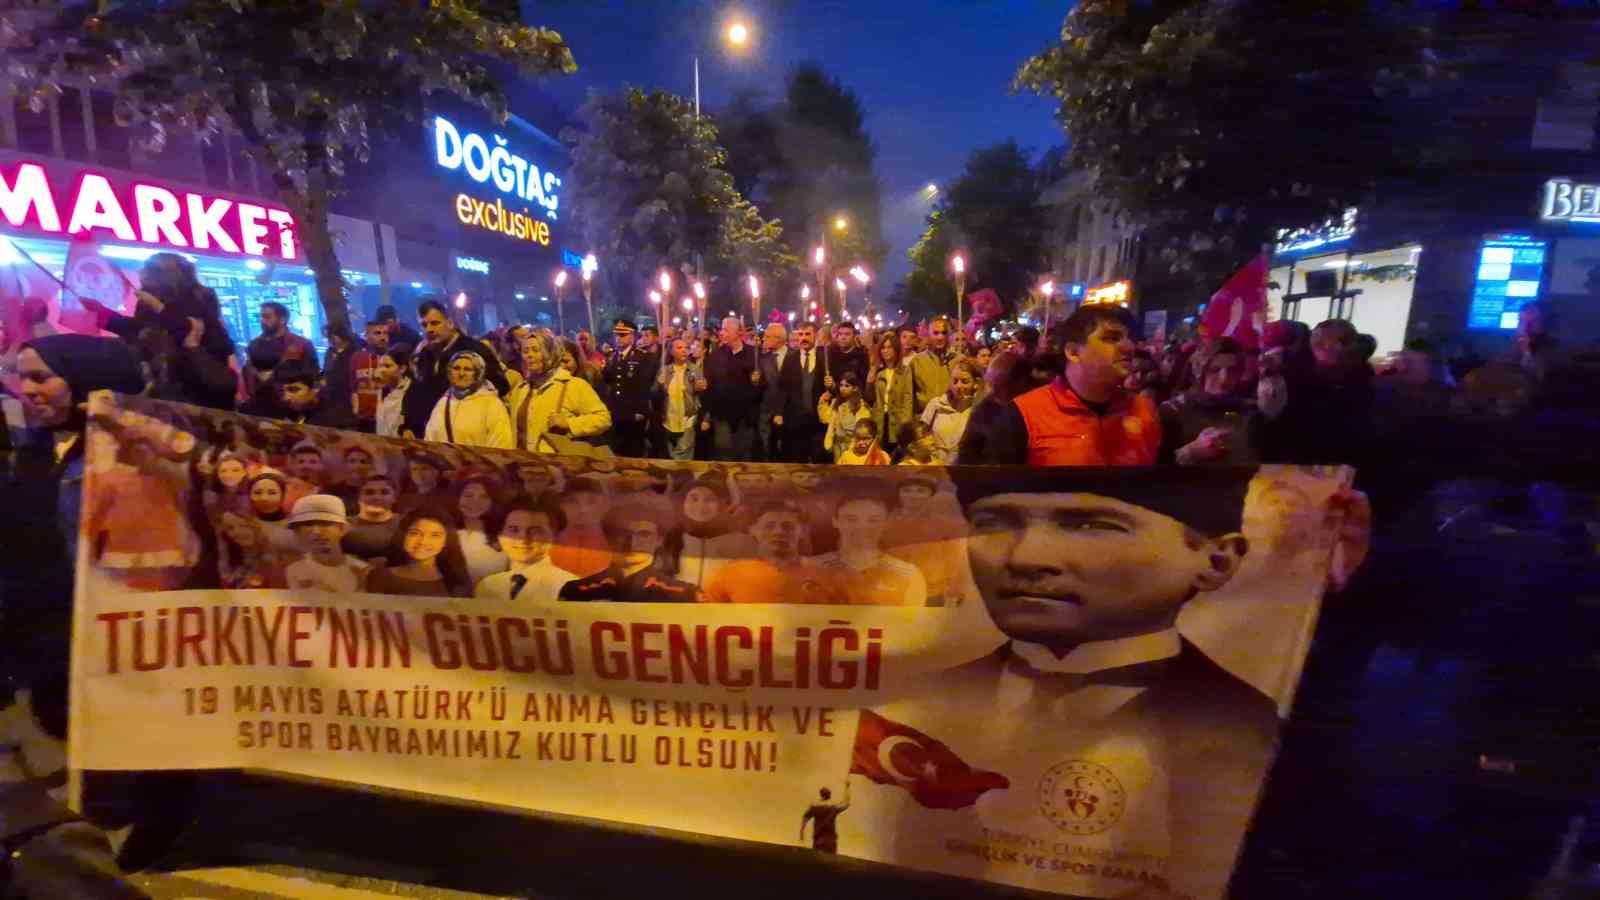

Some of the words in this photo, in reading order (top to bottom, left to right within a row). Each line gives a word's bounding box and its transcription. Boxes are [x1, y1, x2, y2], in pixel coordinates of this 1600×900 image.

[434, 116, 562, 220] DOĞTAŞ
[456, 193, 551, 247] exclusive
[1543, 179, 1600, 221] BE
[425, 613, 574, 675] GÜCÜ
[591, 619, 882, 692] GENÇLİĞİ
[183, 686, 219, 716] 19
[234, 686, 323, 714] MAYIS
[337, 685, 506, 720] ATATÜRK'Ü
[523, 692, 614, 723] ANMA
[631, 700, 777, 734] GENÇLİK
[792, 707, 836, 738] VE
[237, 720, 315, 751] SPOR
[328, 725, 521, 758] BAYRAMIMIZ
[538, 732, 637, 763] KUTLU
